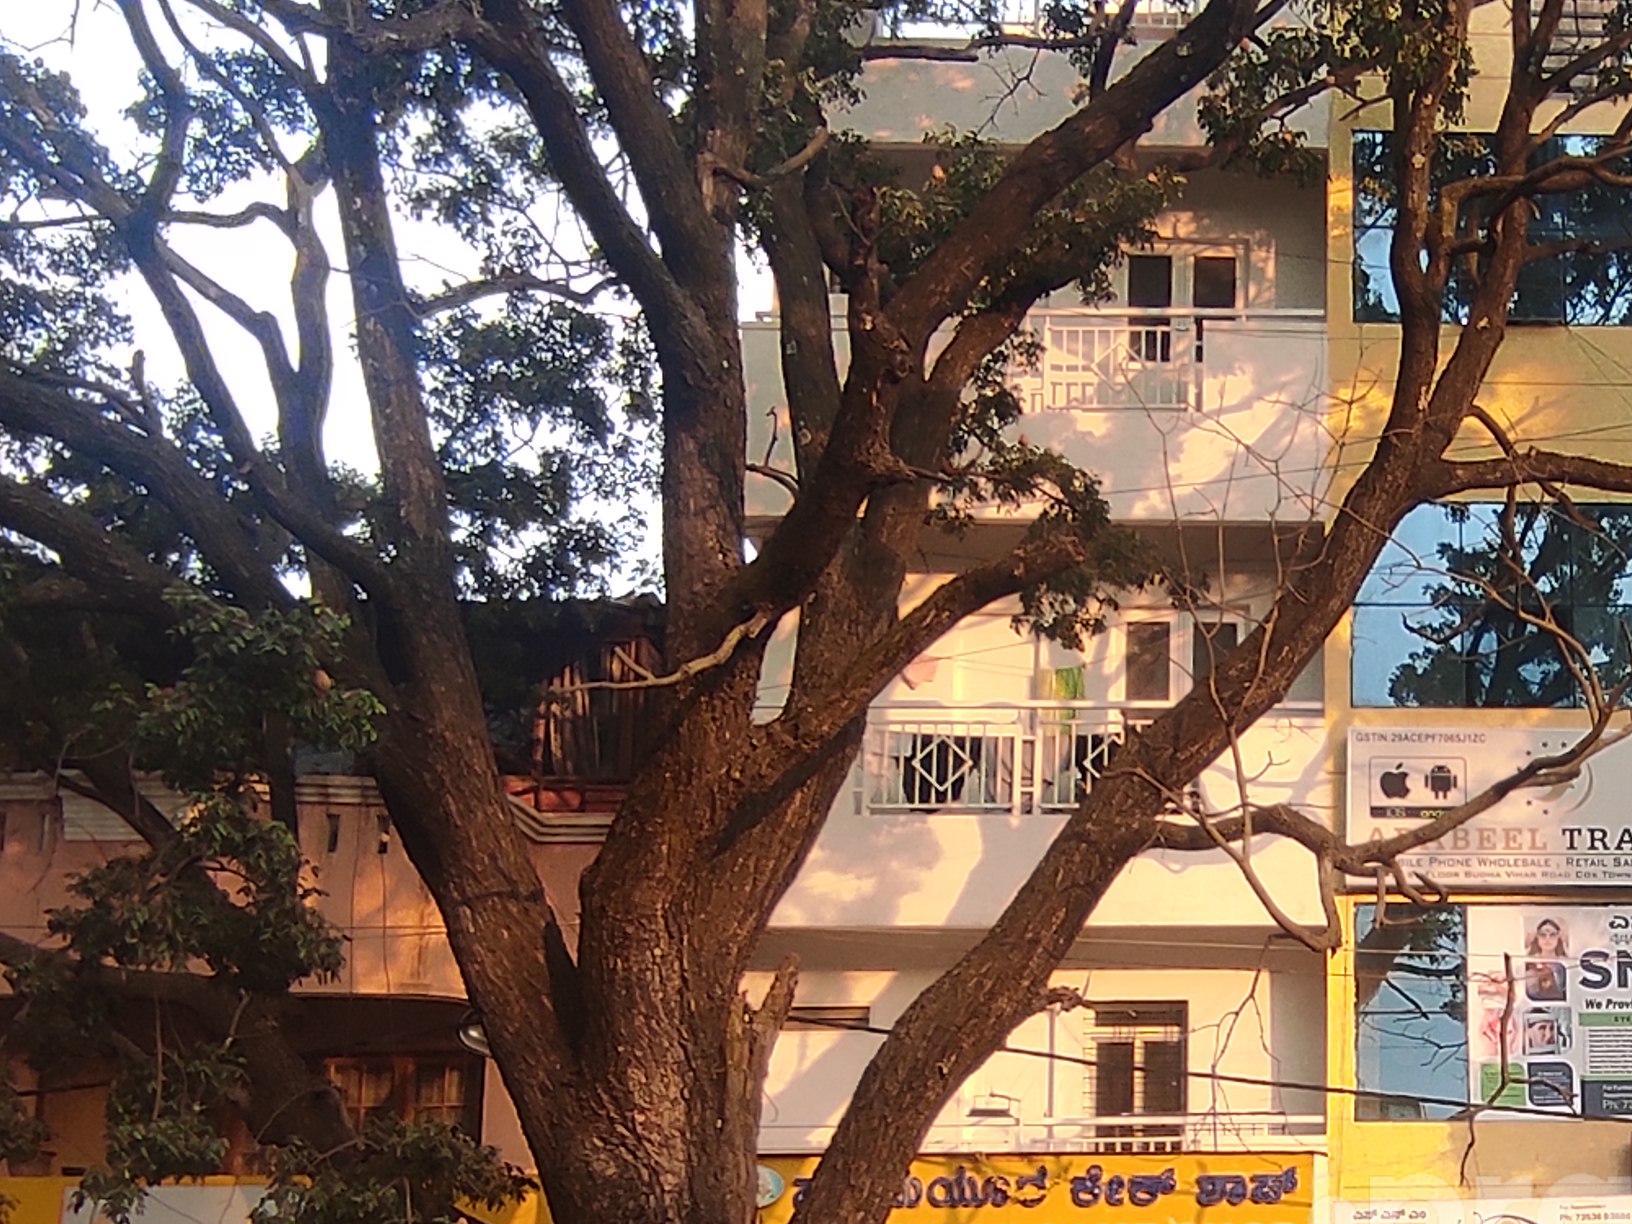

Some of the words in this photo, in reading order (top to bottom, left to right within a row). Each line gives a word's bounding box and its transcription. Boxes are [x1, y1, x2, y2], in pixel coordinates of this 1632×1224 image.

[1428, 857, 1472, 868] PHONE
[1476, 857, 1551, 868] WHOLESALE
[1566, 857, 1608, 868] RETAIL
[1585, 999, 1601, 1010] We
